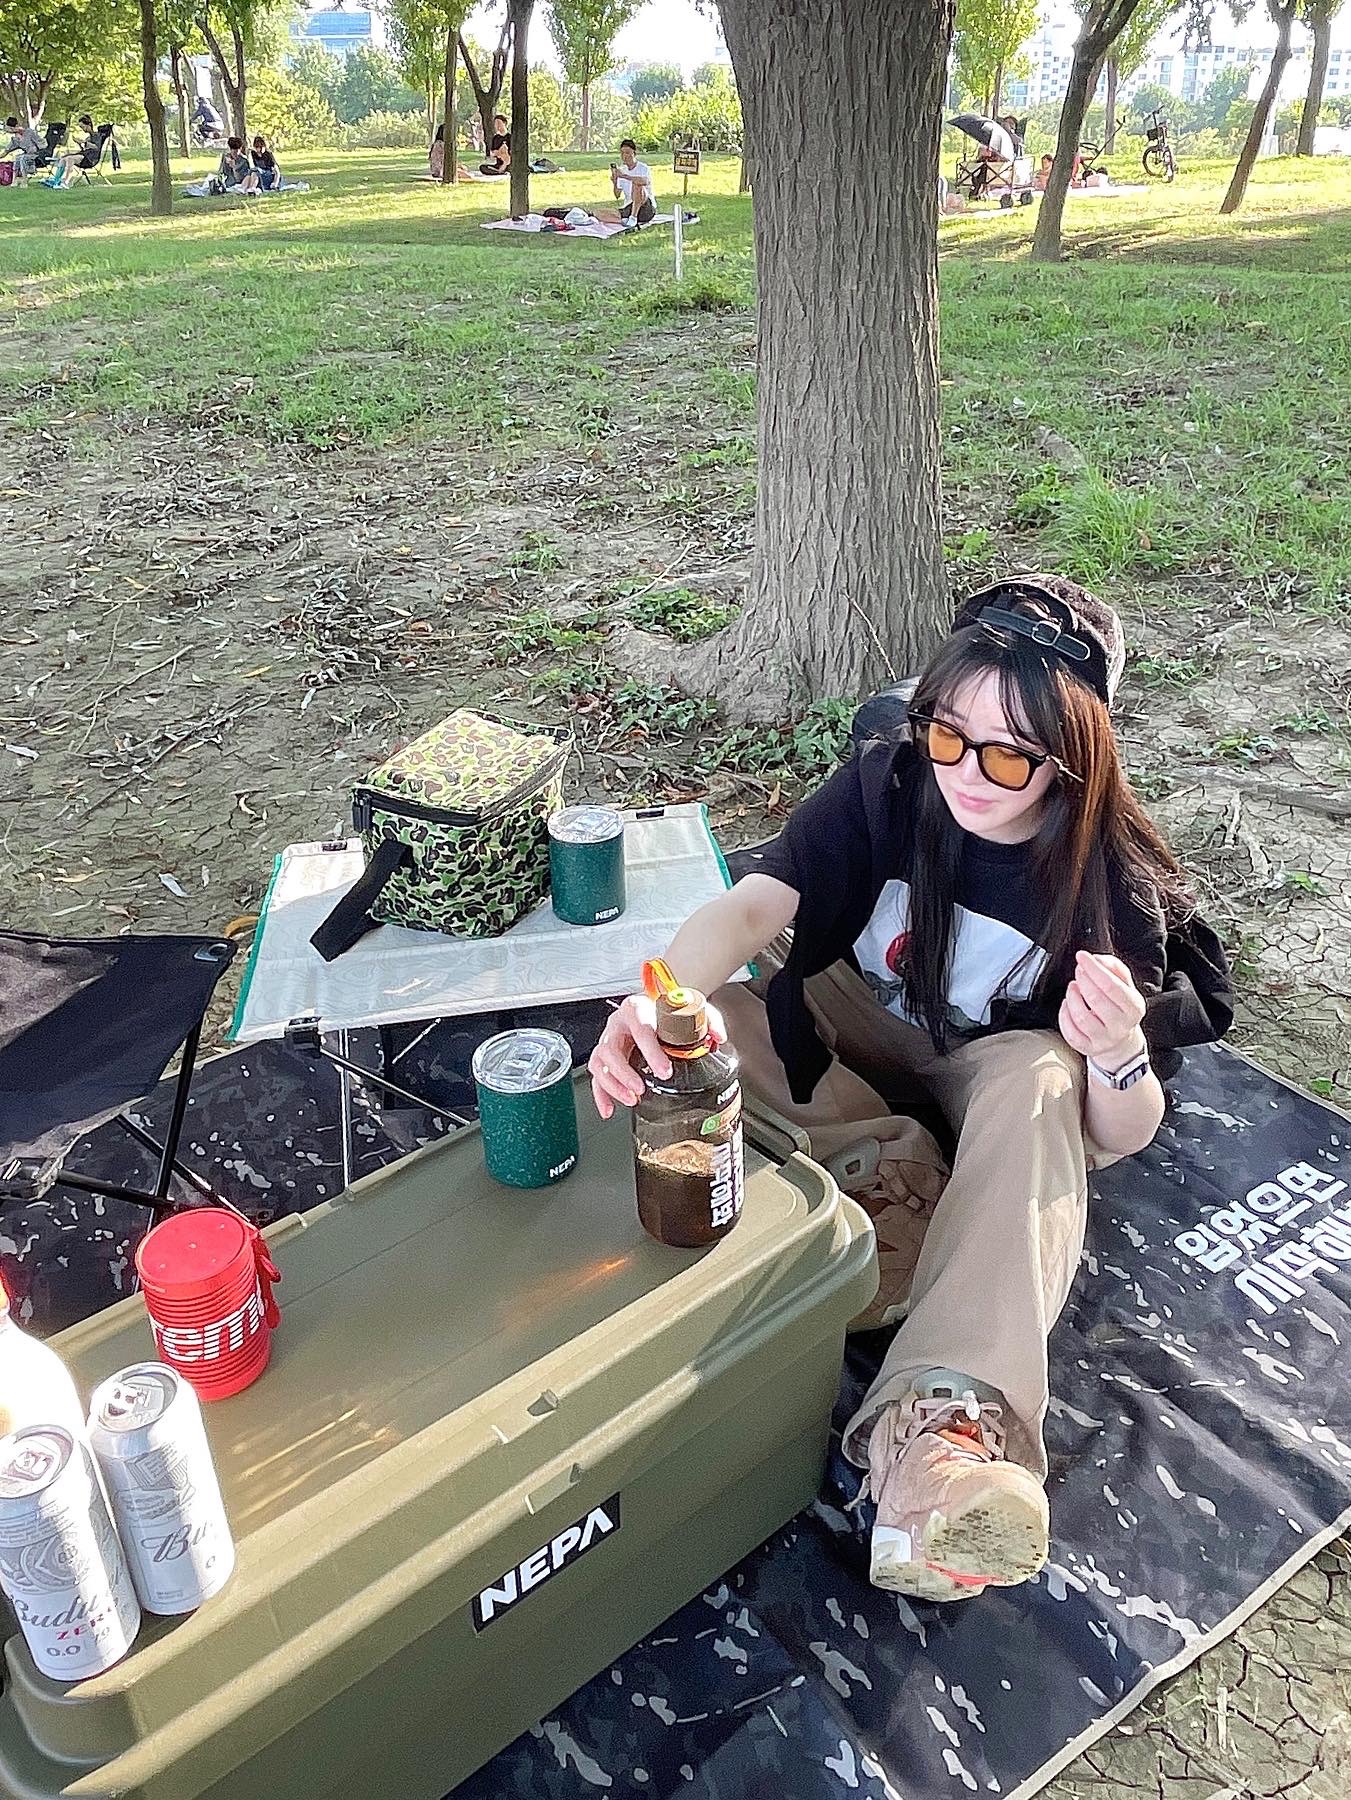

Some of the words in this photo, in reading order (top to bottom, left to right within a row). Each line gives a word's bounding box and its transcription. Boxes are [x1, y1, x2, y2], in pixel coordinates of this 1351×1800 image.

[595, 906, 619, 921] NEPA
[717, 1078, 740, 1105] NE
[1174, 1161, 1349, 1274] 입었으면
[1234, 1199, 1351, 1315] 시작해
[479, 1506, 615, 1623] NEPA
[56, 1607, 112, 1641] ZER
